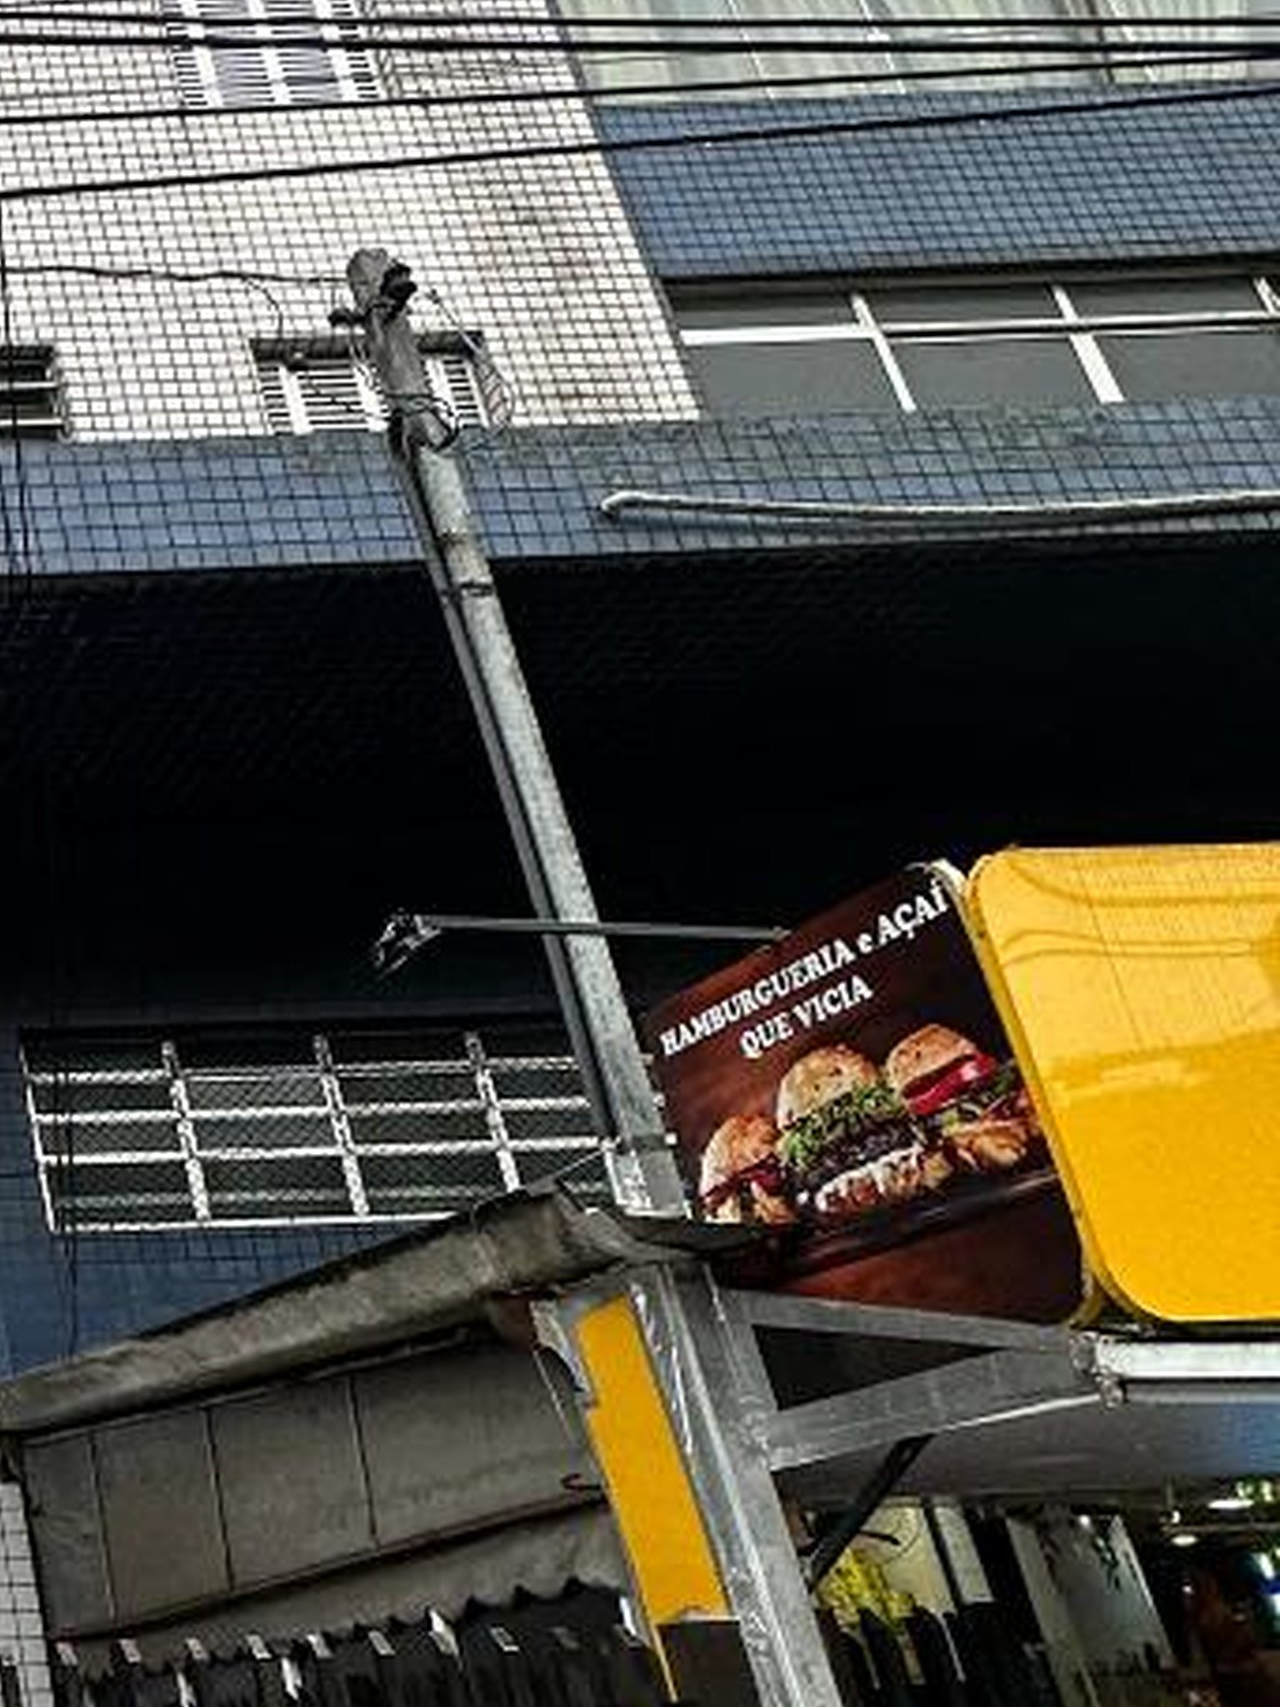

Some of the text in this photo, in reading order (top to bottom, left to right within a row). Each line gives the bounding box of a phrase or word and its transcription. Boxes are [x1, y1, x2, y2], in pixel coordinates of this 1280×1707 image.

[659, 876, 950, 1057] HAMBURGUERIA e AÇAÍ
[739, 975, 874, 1060] QUE VICIA
